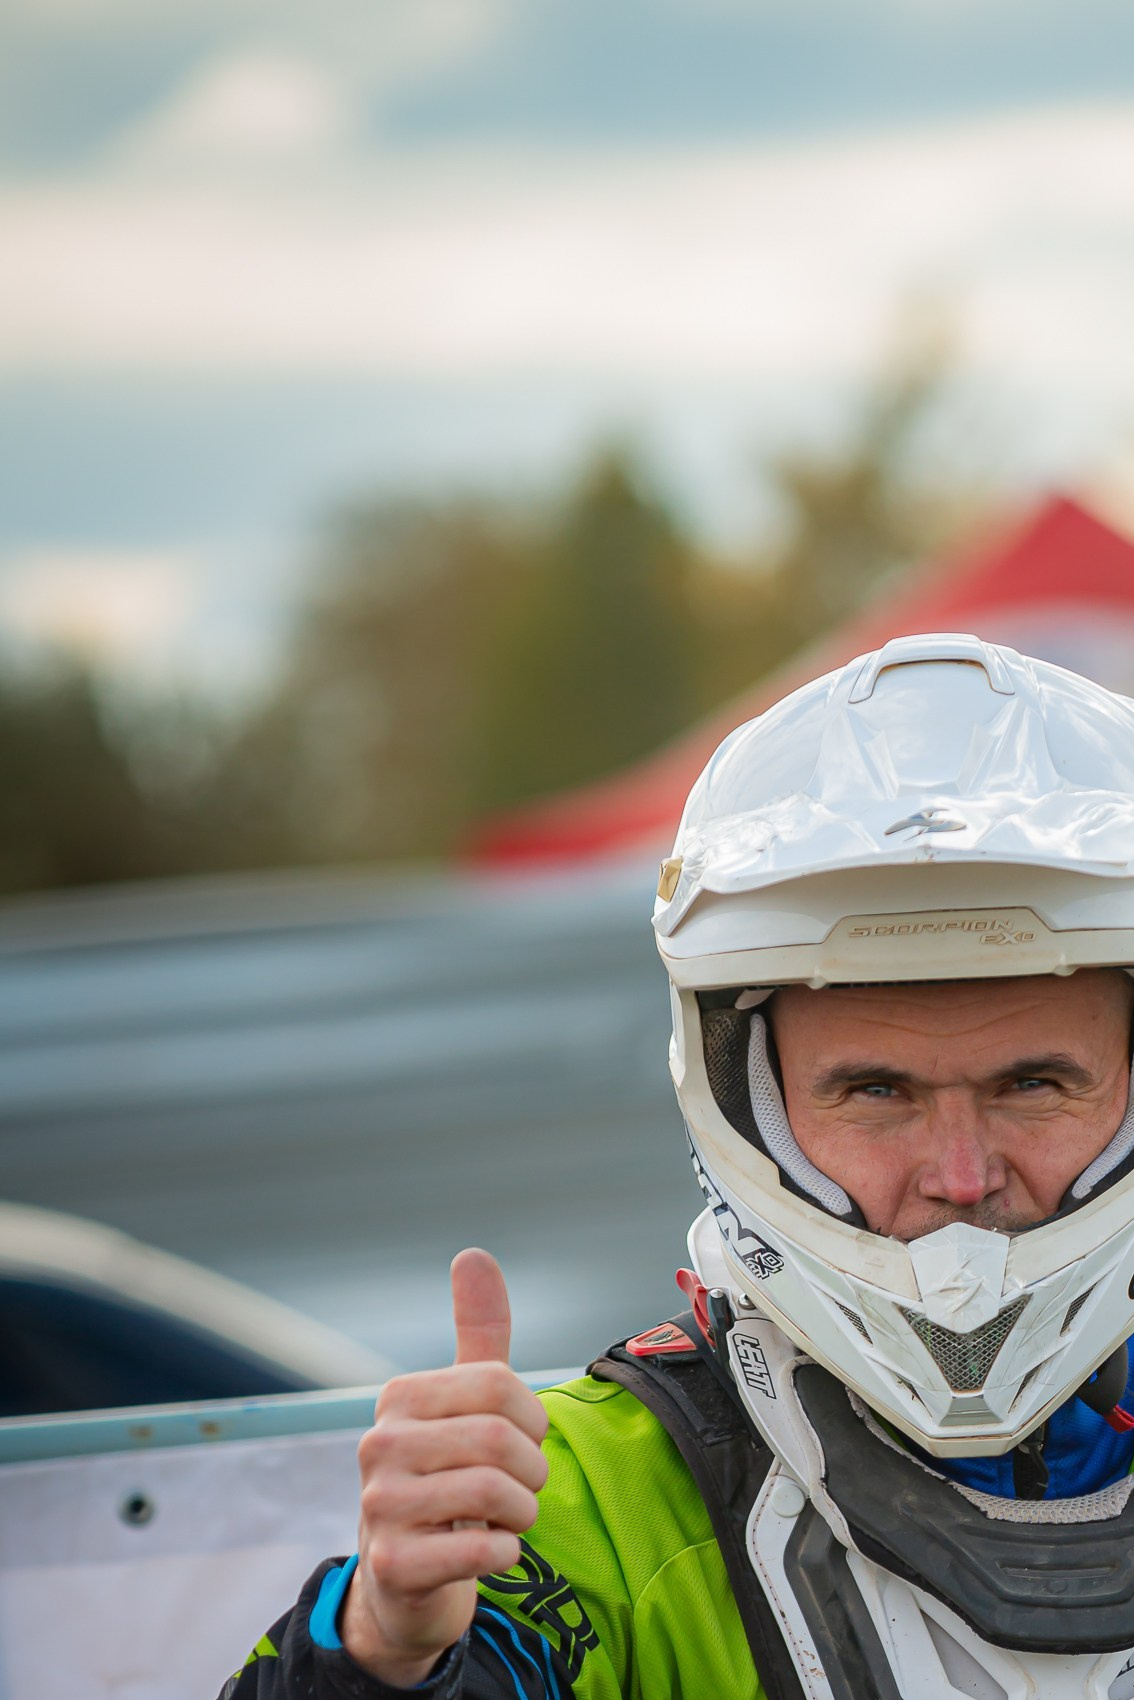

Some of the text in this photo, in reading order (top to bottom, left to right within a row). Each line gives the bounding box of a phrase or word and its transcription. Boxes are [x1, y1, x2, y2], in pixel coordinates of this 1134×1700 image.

[849, 917, 1033, 938] SCORPION
[979, 930, 1037, 946] EXO
[732, 1332, 777, 1400] LEATT
